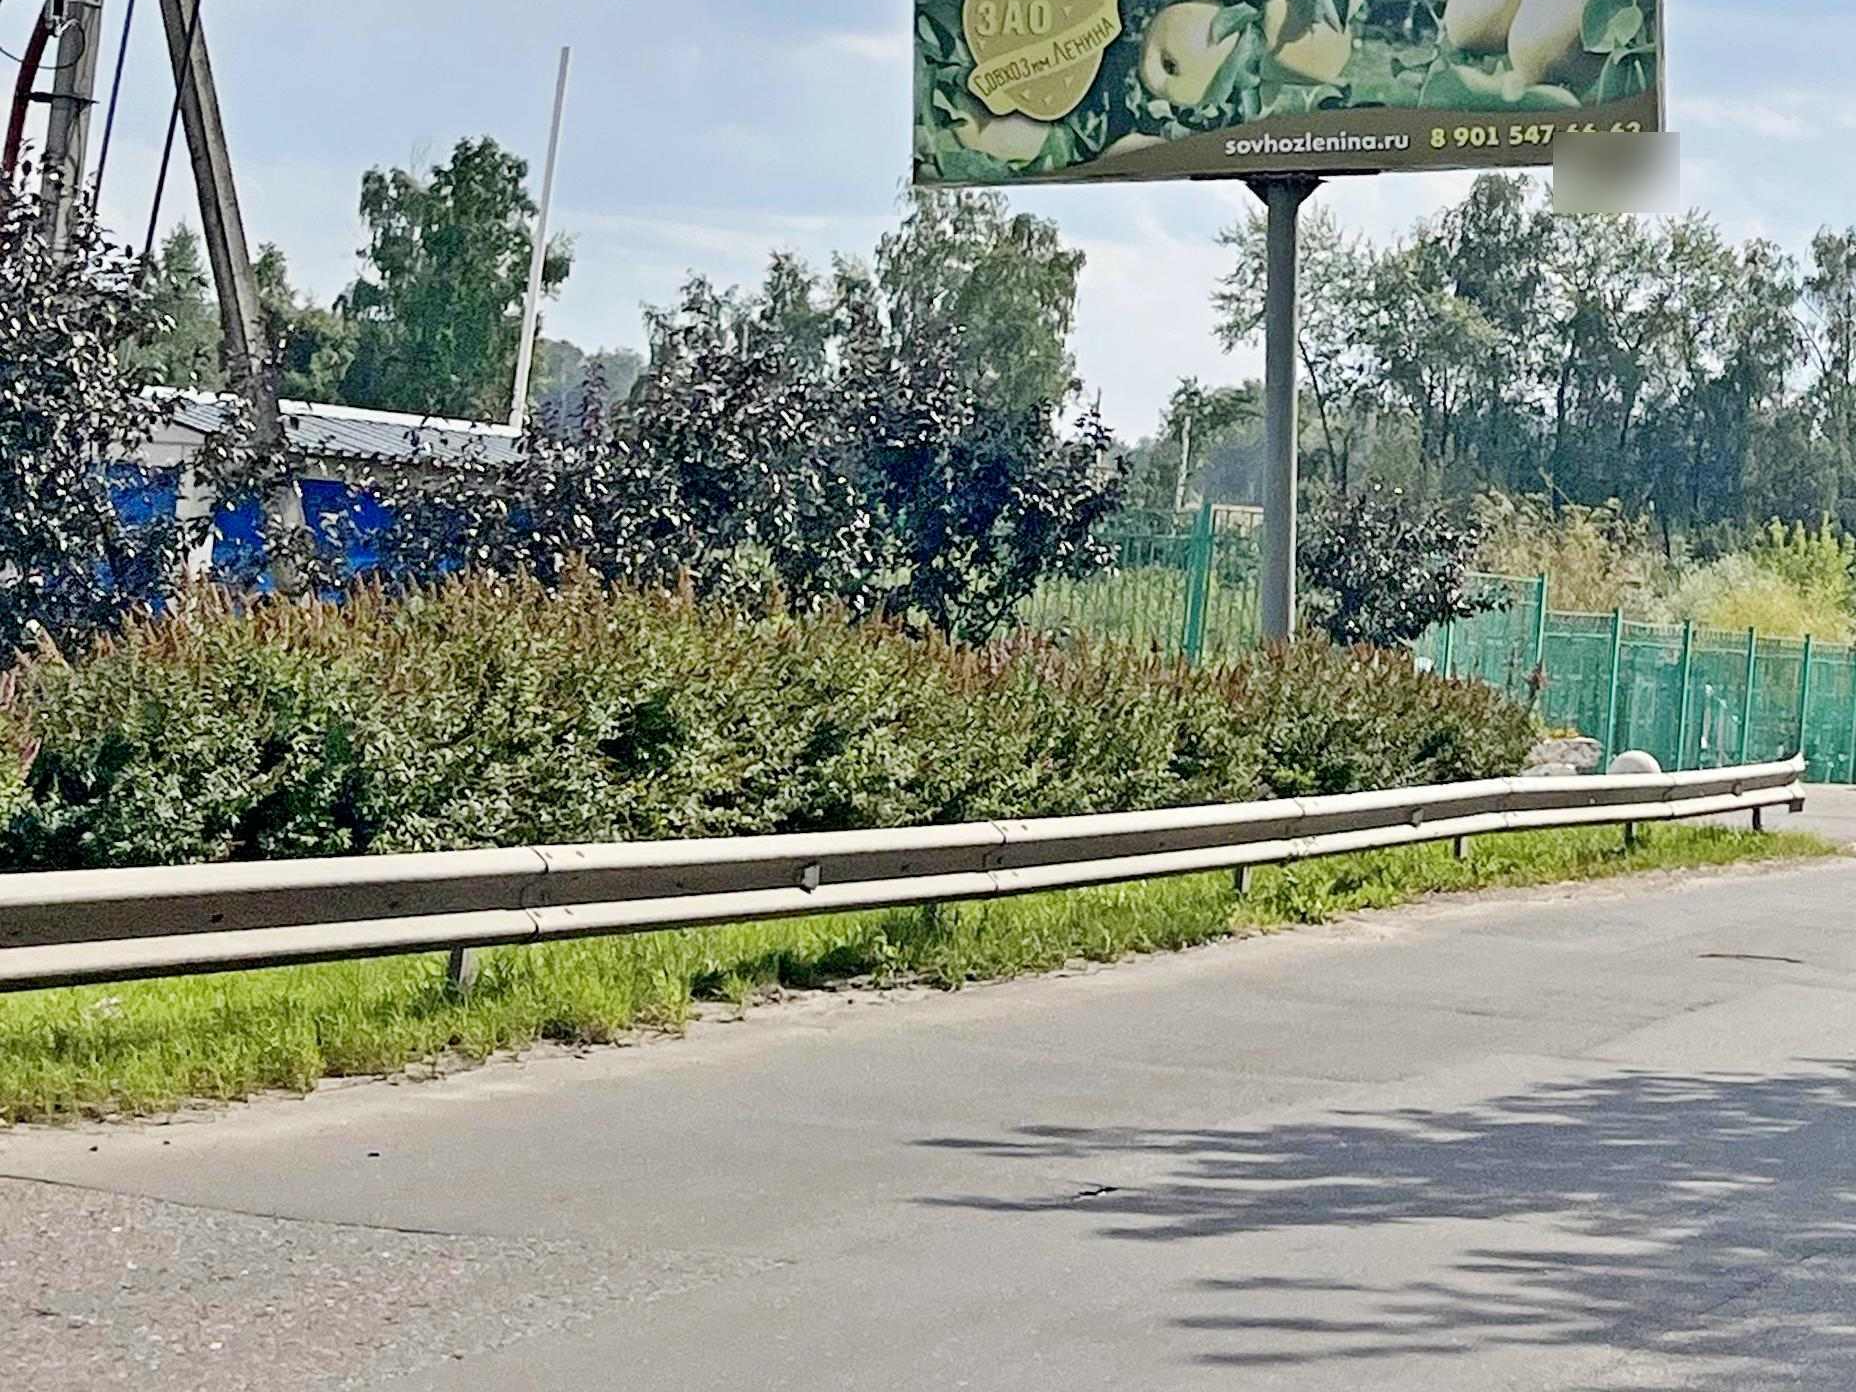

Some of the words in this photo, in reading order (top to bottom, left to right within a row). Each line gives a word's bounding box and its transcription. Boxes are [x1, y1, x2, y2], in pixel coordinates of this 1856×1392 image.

[976, 0, 1051, 37] ЗАО
[1224, 131, 1410, 155] sovhozlenina.ru
[1430, 127, 1446, 148] 8
[1453, 126, 1499, 147] 901
[1508, 124, 1554, 145] 547
